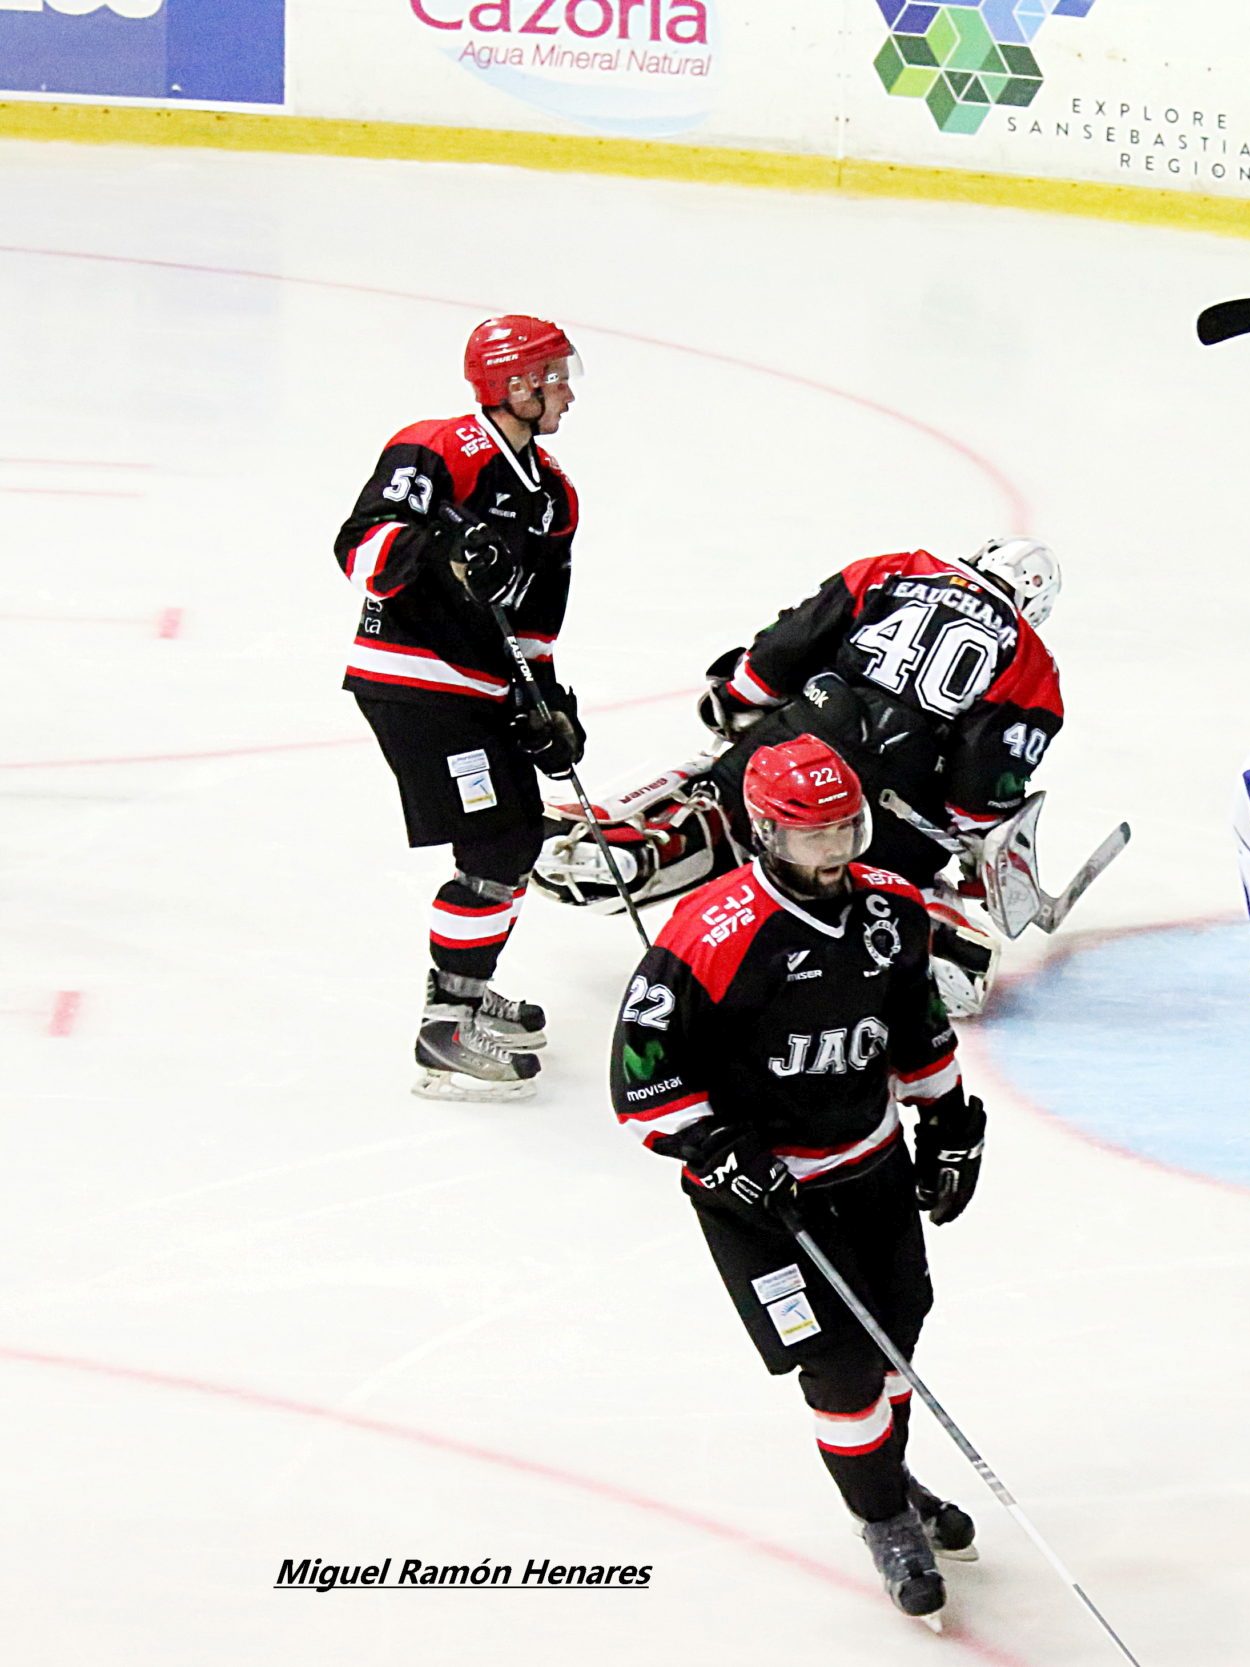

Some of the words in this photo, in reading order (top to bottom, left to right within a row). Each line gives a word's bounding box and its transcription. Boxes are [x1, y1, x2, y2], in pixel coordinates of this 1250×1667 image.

[459, 40, 523, 69] Agua
[531, 43, 619, 71] Mineral
[626, 49, 712, 77] Natural
[1072, 98, 1227, 129] EXPLORE
[383, 466, 433, 514] 53
[506, 635, 533, 682] EASTON
[850, 599, 998, 720] 40
[1003, 722, 1047, 765] 40
[809, 767, 838, 787] 22
[701, 907, 756, 947] 1972
[866, 894, 892, 917] C
[621, 974, 676, 1031] 22
[768, 1016, 889, 1079] JAC
